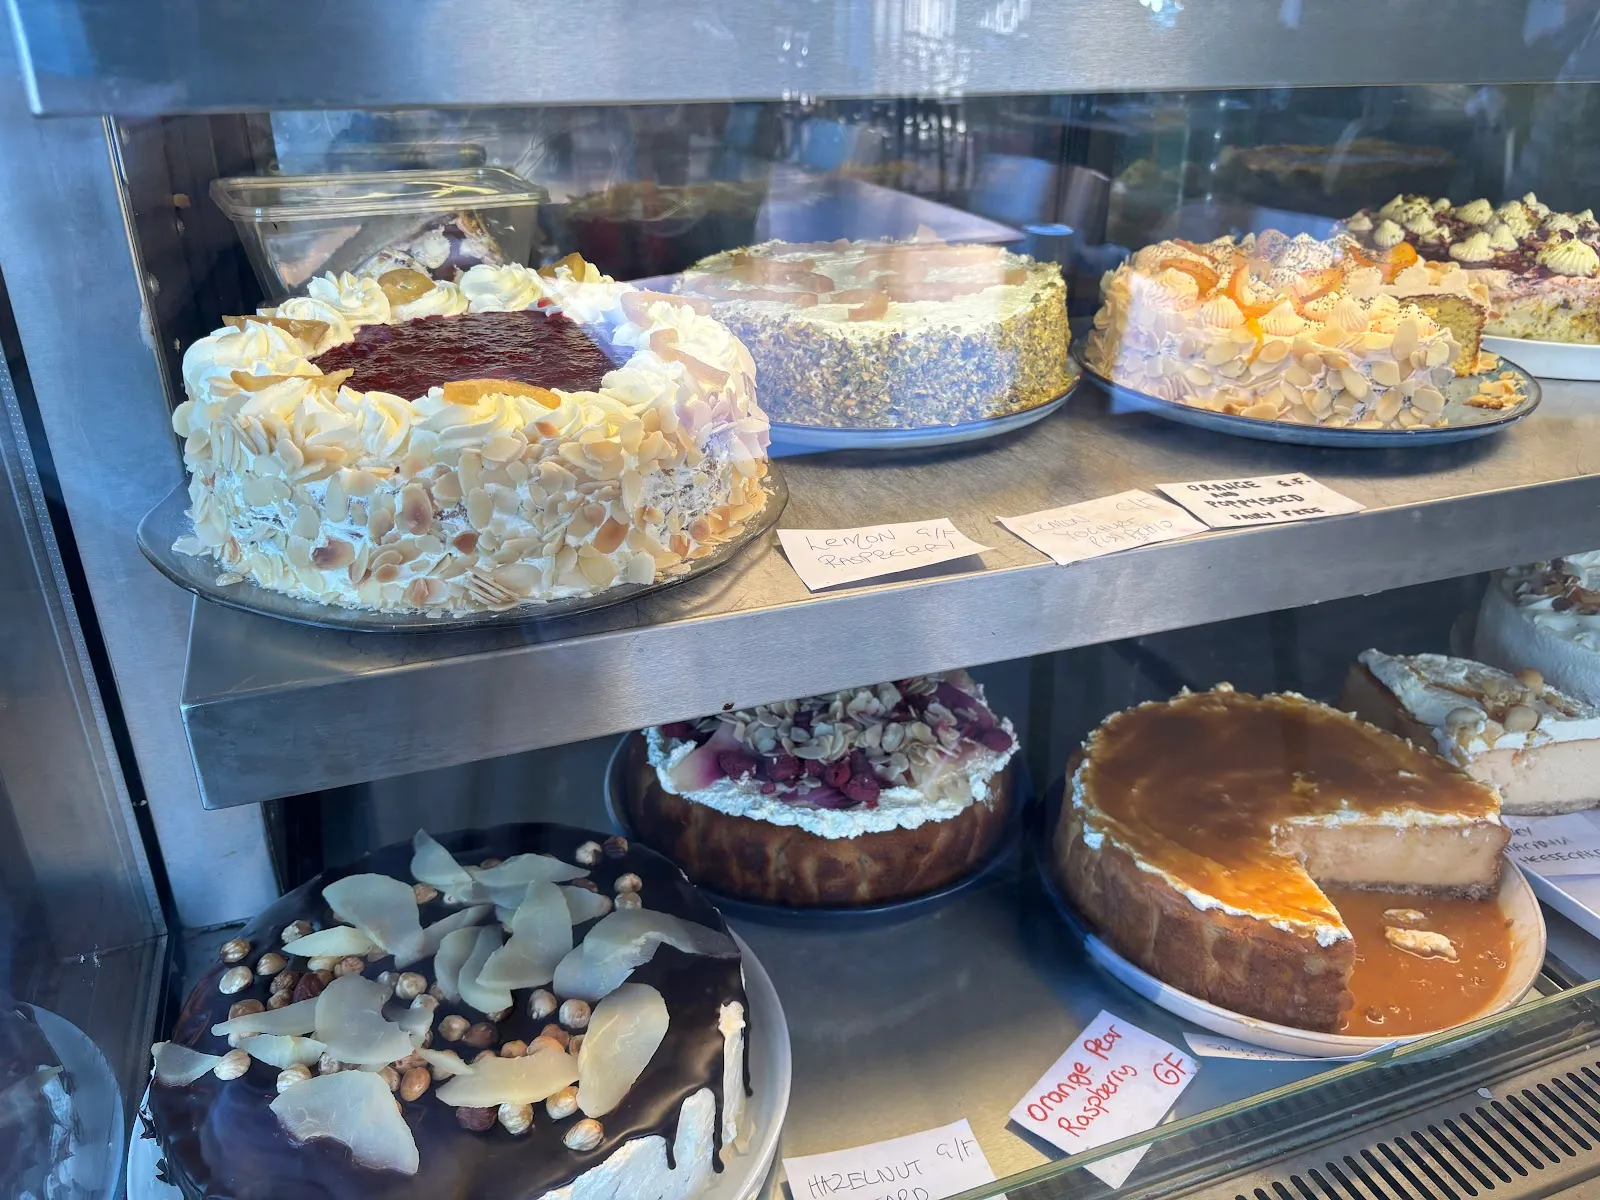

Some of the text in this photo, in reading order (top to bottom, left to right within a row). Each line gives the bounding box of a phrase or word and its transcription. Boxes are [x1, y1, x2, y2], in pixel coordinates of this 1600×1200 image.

[1187, 480, 1261, 492] ORANGE
[1204, 494, 1305, 509] POPPYSEED
[1229, 506, 1325, 520] DAIRY FREE
[818, 540, 956, 569] RASPBERRY
[1153, 1052, 1186, 1085] GF
[1027, 1062, 1091, 1121] Orange
[1058, 1064, 1138, 1137] Raspberry
[808, 1159, 923, 1198] HAZELNUT
